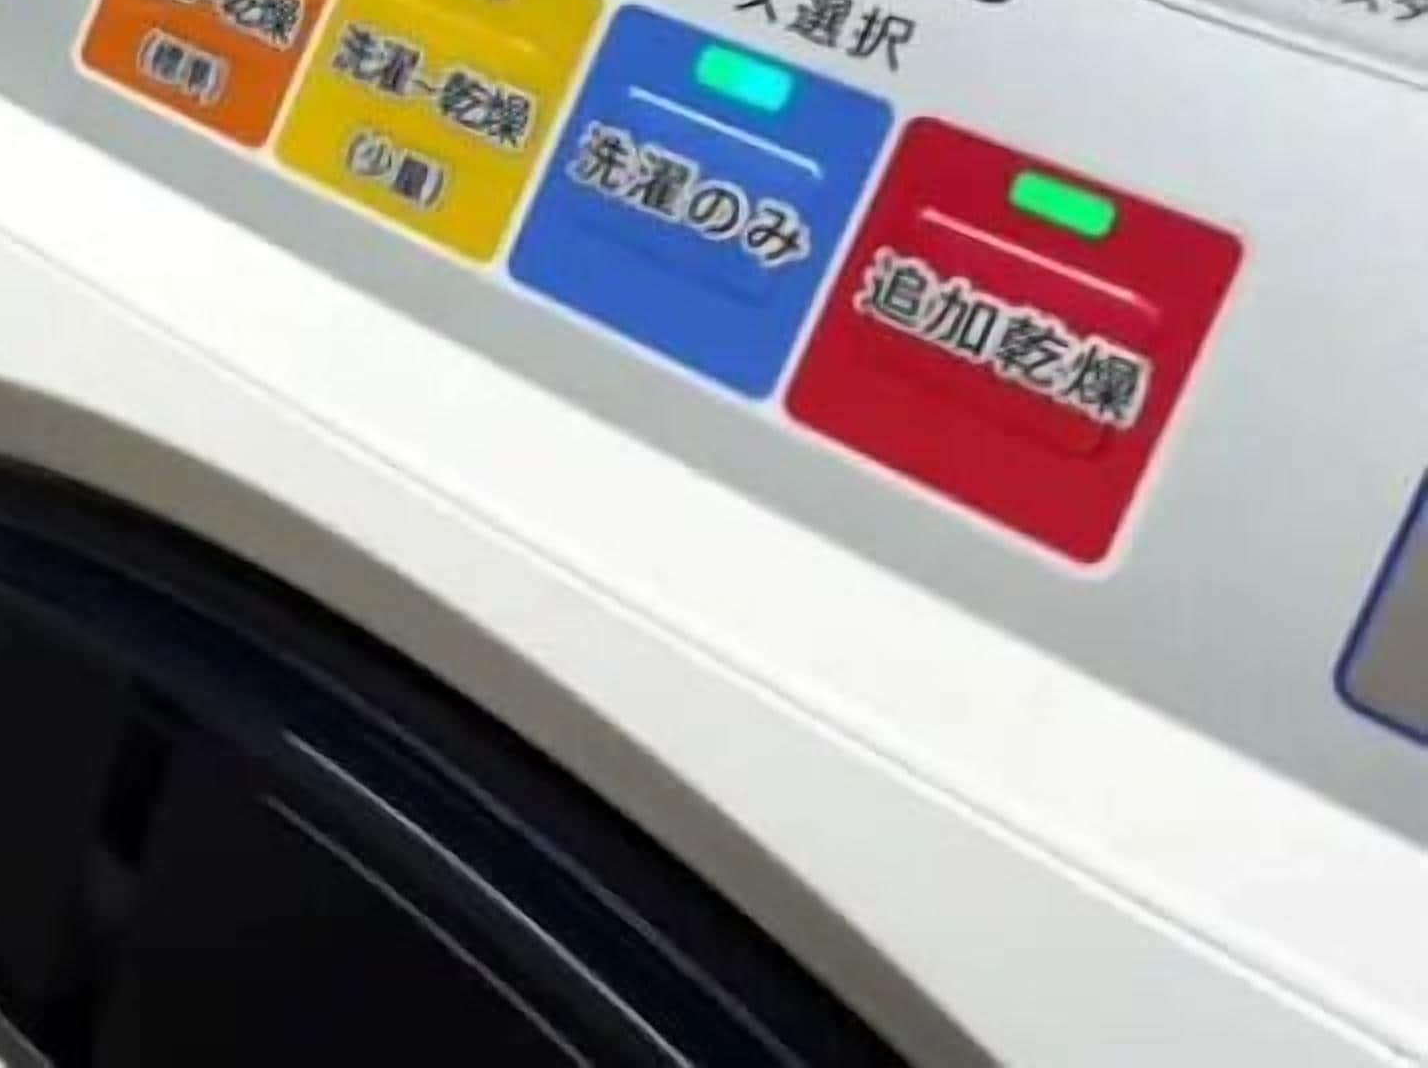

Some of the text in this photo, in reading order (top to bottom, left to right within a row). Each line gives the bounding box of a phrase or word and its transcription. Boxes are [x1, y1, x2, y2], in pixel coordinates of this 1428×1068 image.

[573, 127, 807, 264] 洗濯のみ
[860, 253, 1146, 422] 追加乾燥
